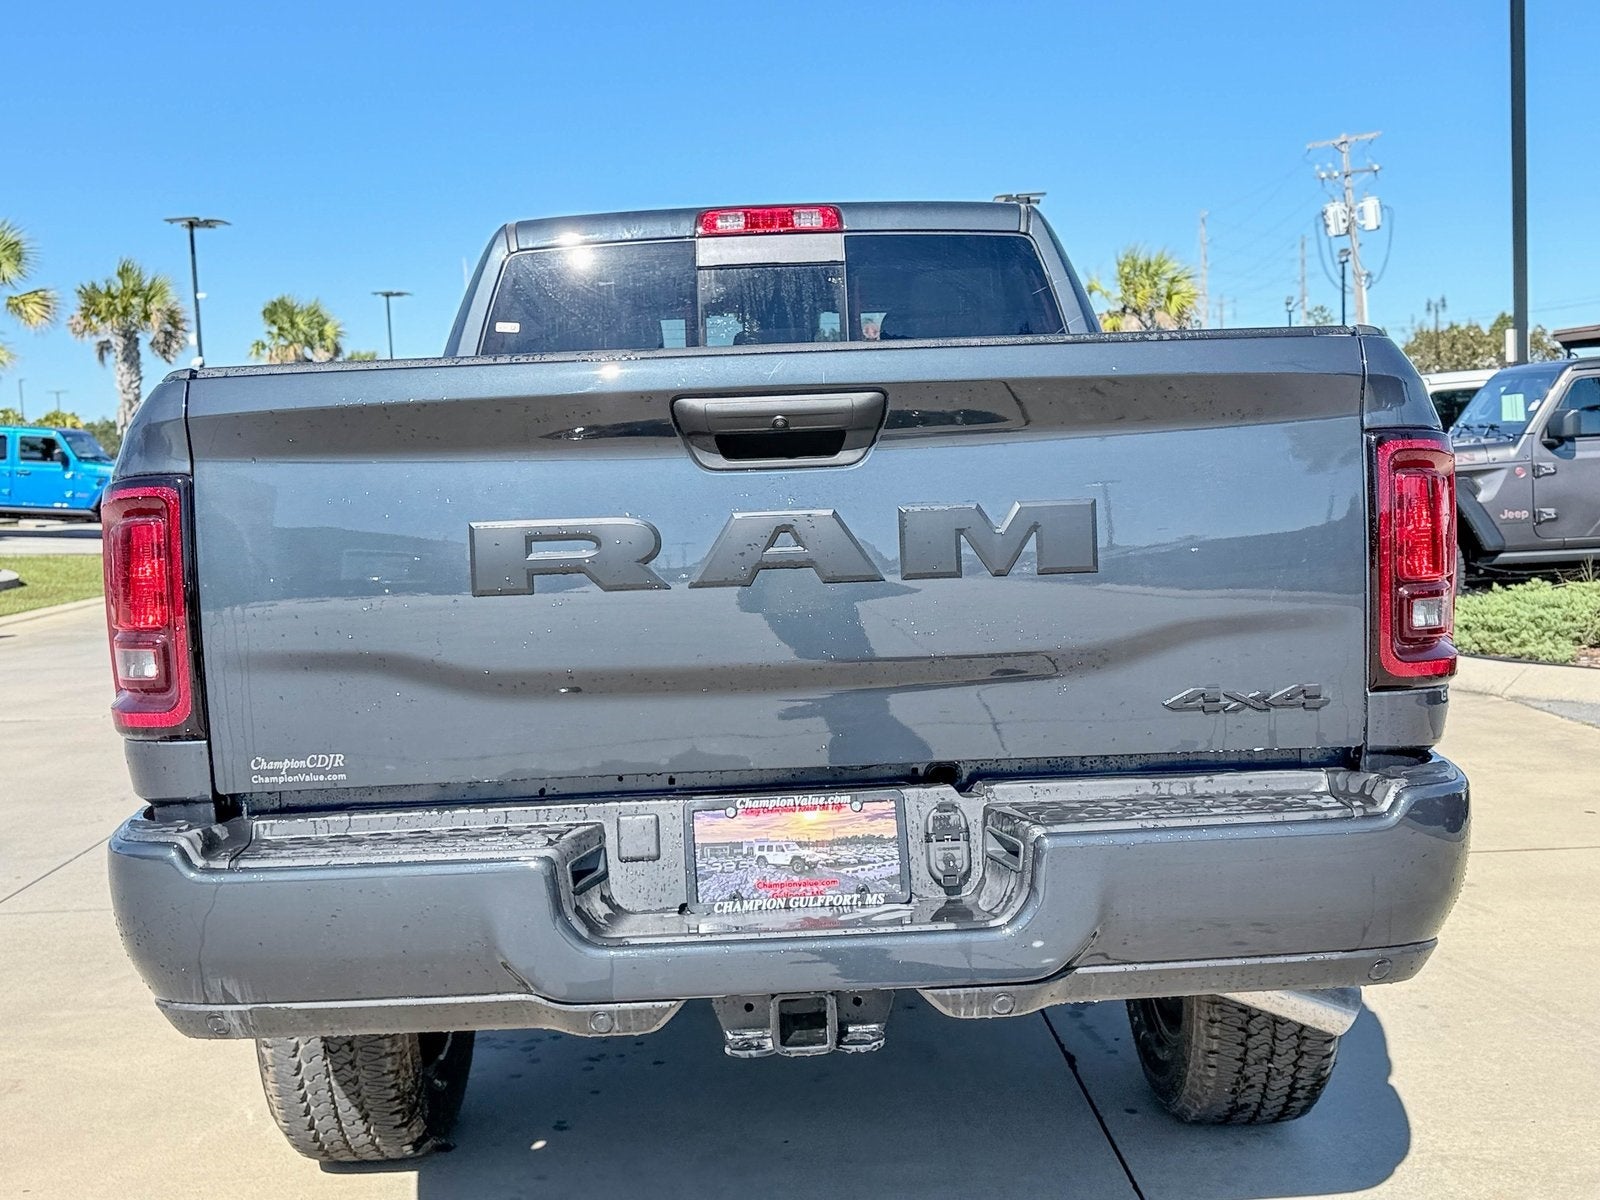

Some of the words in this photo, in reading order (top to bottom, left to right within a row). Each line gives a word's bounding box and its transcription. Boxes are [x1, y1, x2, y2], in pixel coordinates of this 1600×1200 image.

[1500, 509, 1529, 519] Jeep
[469, 499, 1099, 596] RAM
[1162, 683, 1330, 715] 4x4
[250, 753, 345, 774] ChampionCDJR
[251, 772, 347, 784] ChampionValue.com
[736, 795, 851, 809] ChampionValue.com
[714, 898, 786, 913] CHAMPION
[789, 895, 861, 909] GULFPORT,
[865, 893, 885, 905] MS
